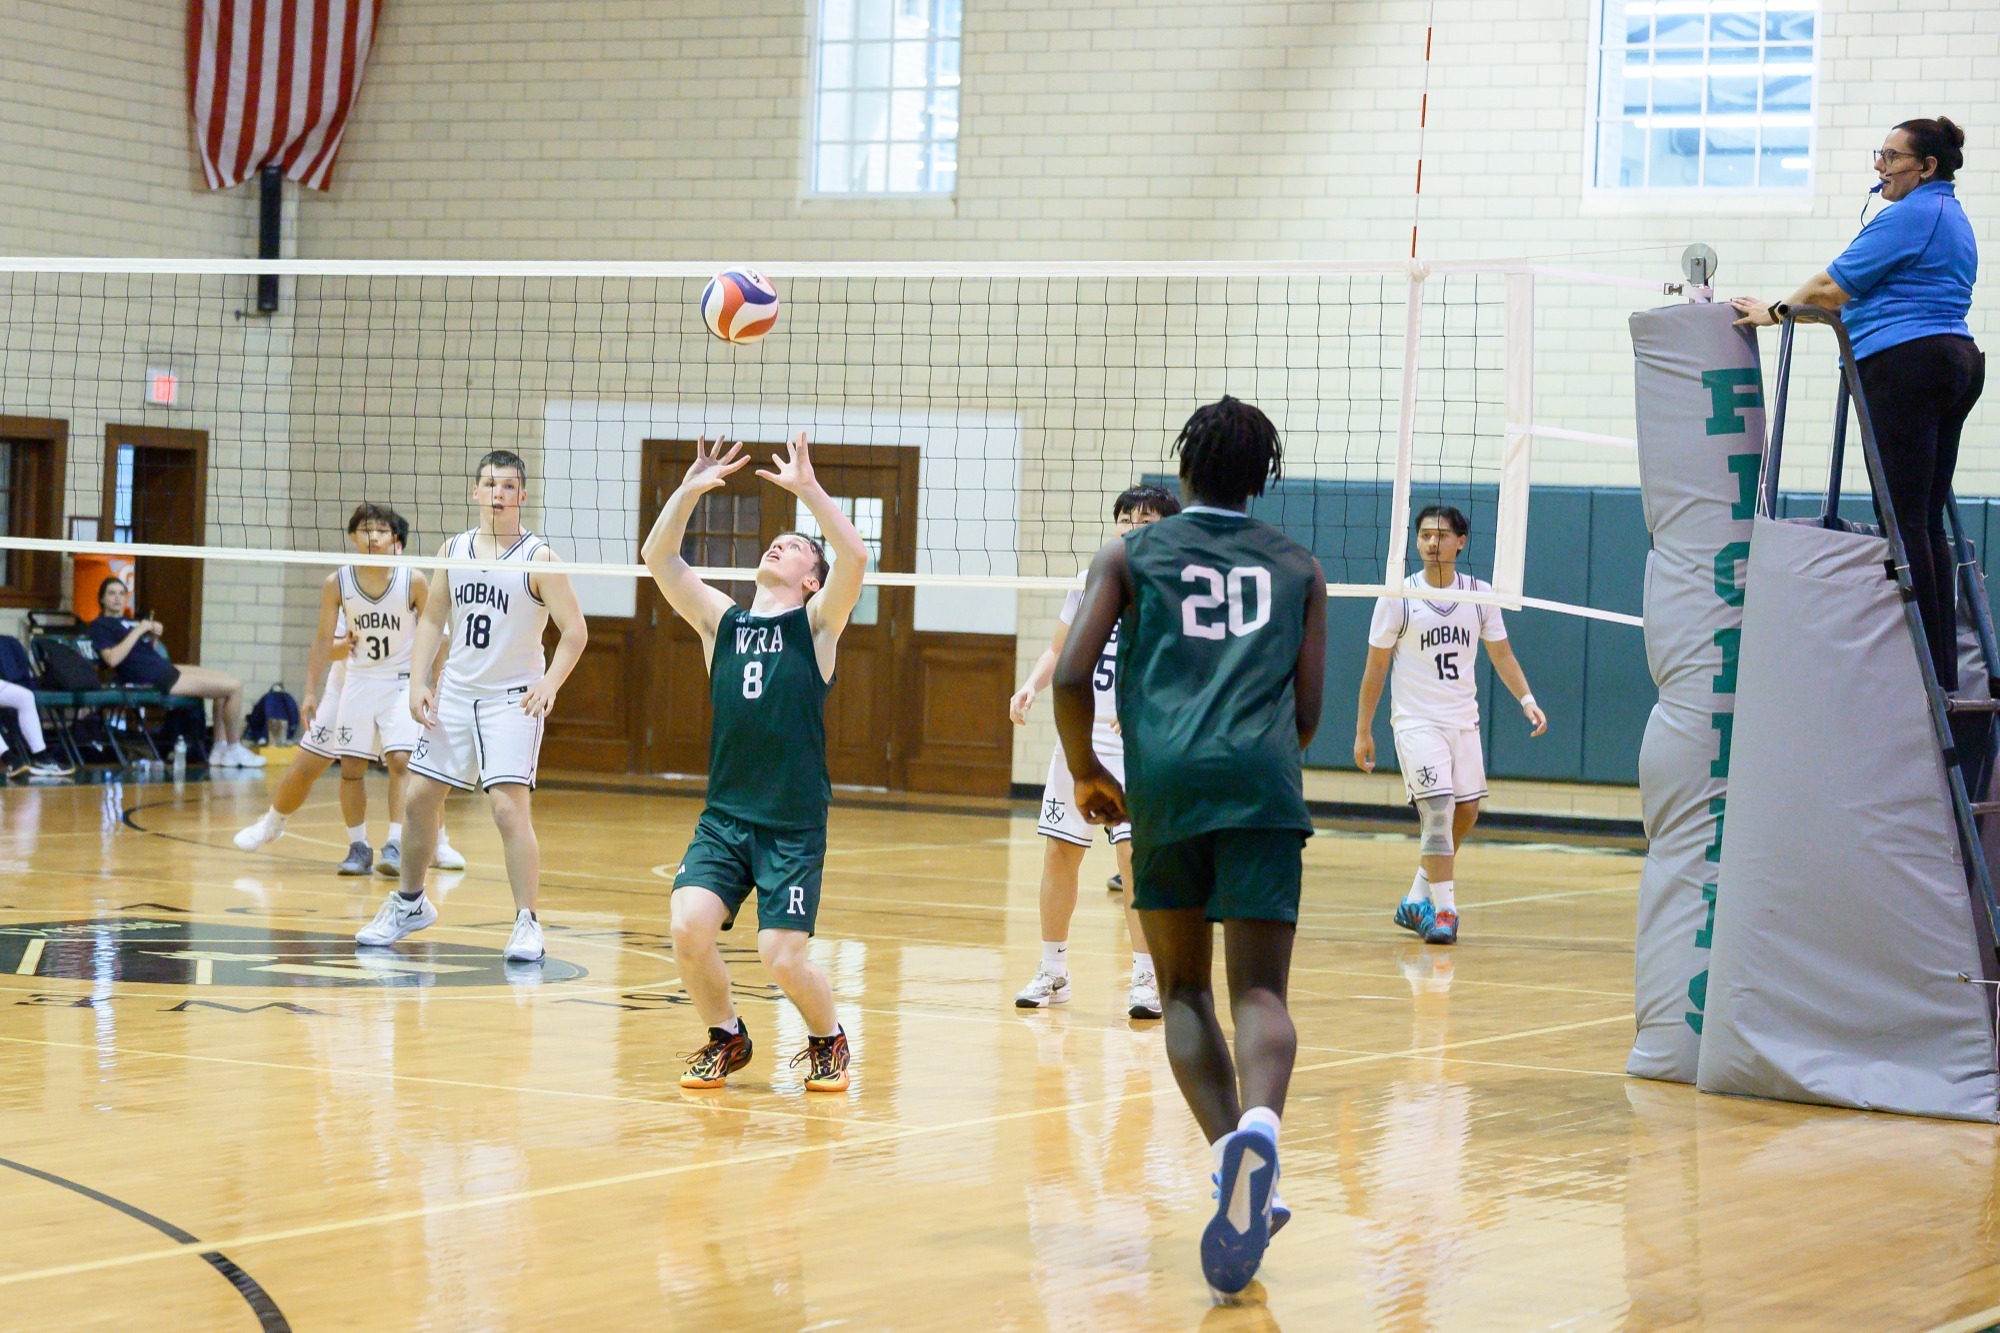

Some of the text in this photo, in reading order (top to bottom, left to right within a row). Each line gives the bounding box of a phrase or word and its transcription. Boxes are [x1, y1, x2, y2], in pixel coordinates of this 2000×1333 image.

[455, 583, 509, 615] HOBAN
[1181, 564, 1272, 640] 20
[354, 612, 400, 631] HOBAN
[465, 613, 492, 649] 18
[366, 636, 390, 660] 31
[736, 625, 783, 654] WRA
[1421, 626, 1470, 651] HOBAN
[743, 661, 763, 699] 8
[1434, 652, 1459, 680] 15
[787, 886, 806, 915] R
